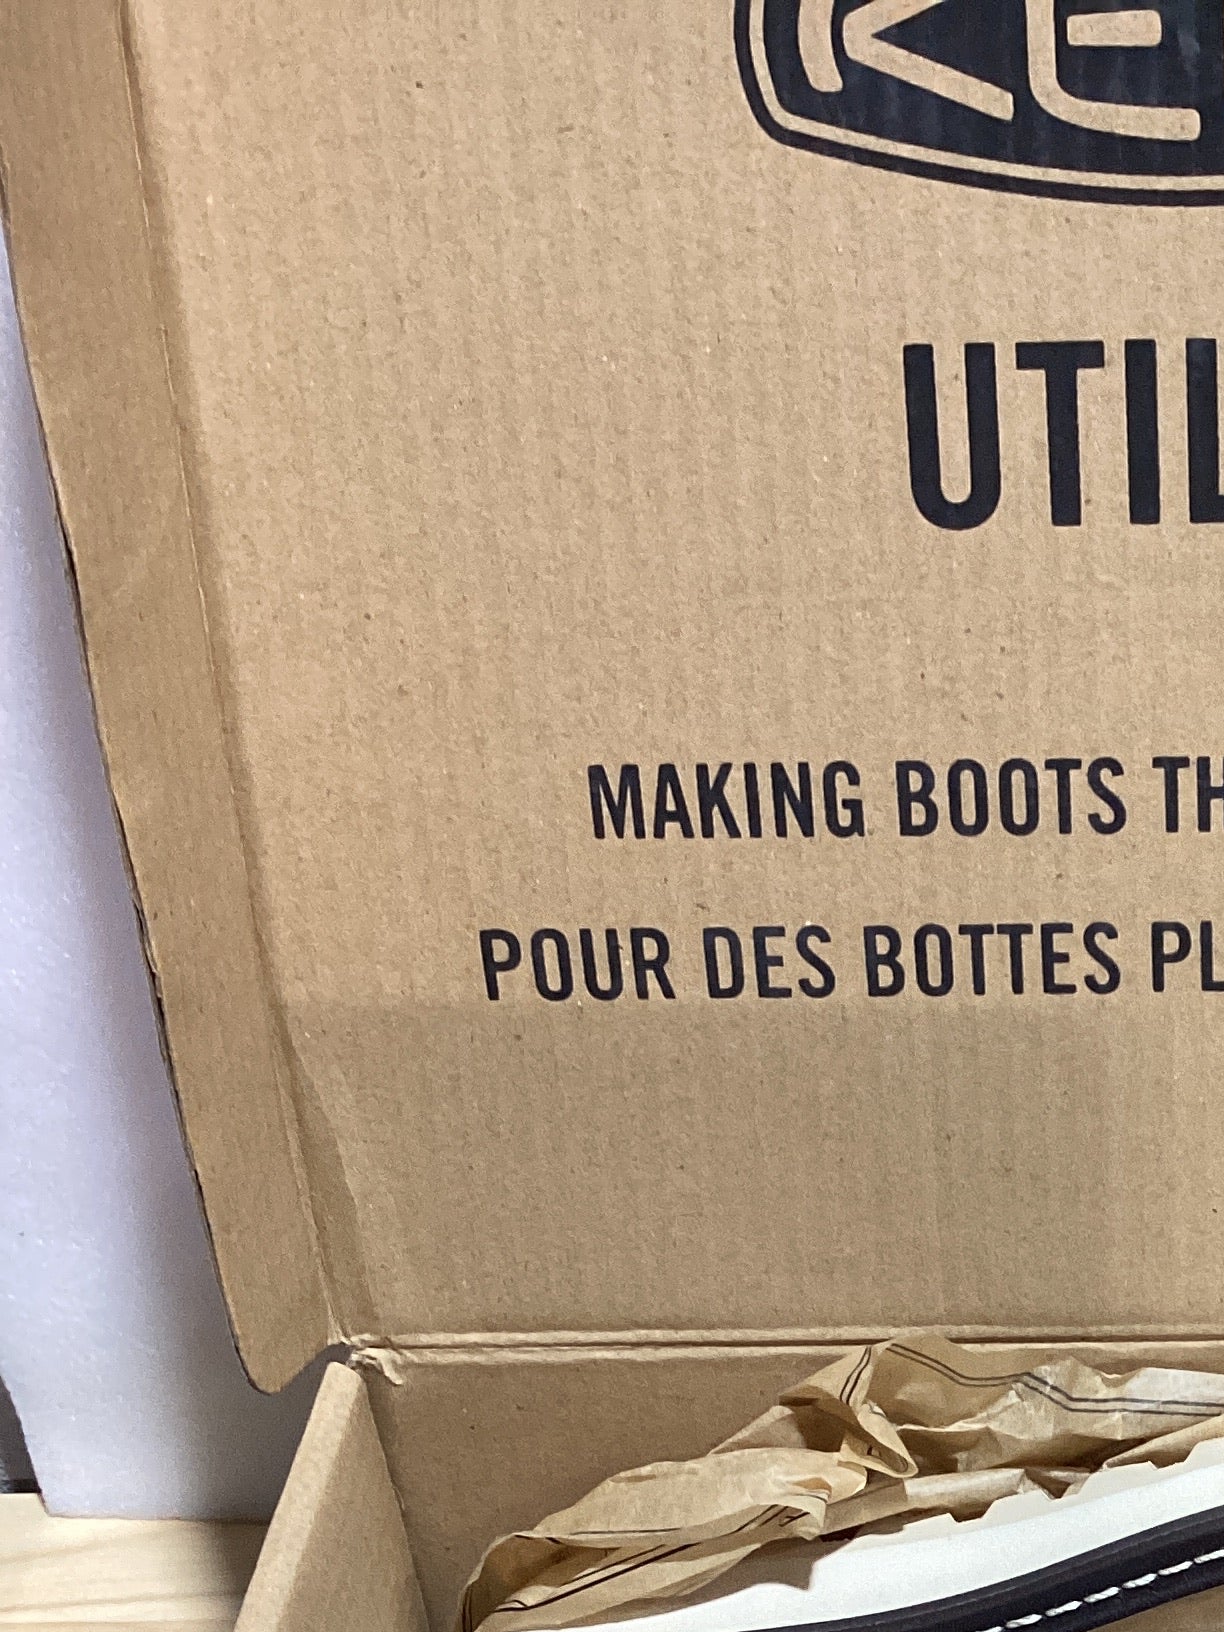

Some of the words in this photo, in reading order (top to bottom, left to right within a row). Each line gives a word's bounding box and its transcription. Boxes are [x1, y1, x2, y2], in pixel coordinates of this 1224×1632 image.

[587, 760, 865, 839] MAKING
[895, 757, 1127, 837] BOOTS
[479, 927, 676, 1001] POUR
[702, 924, 836, 999] DES
[863, 921, 1121, 998] BOTTES
